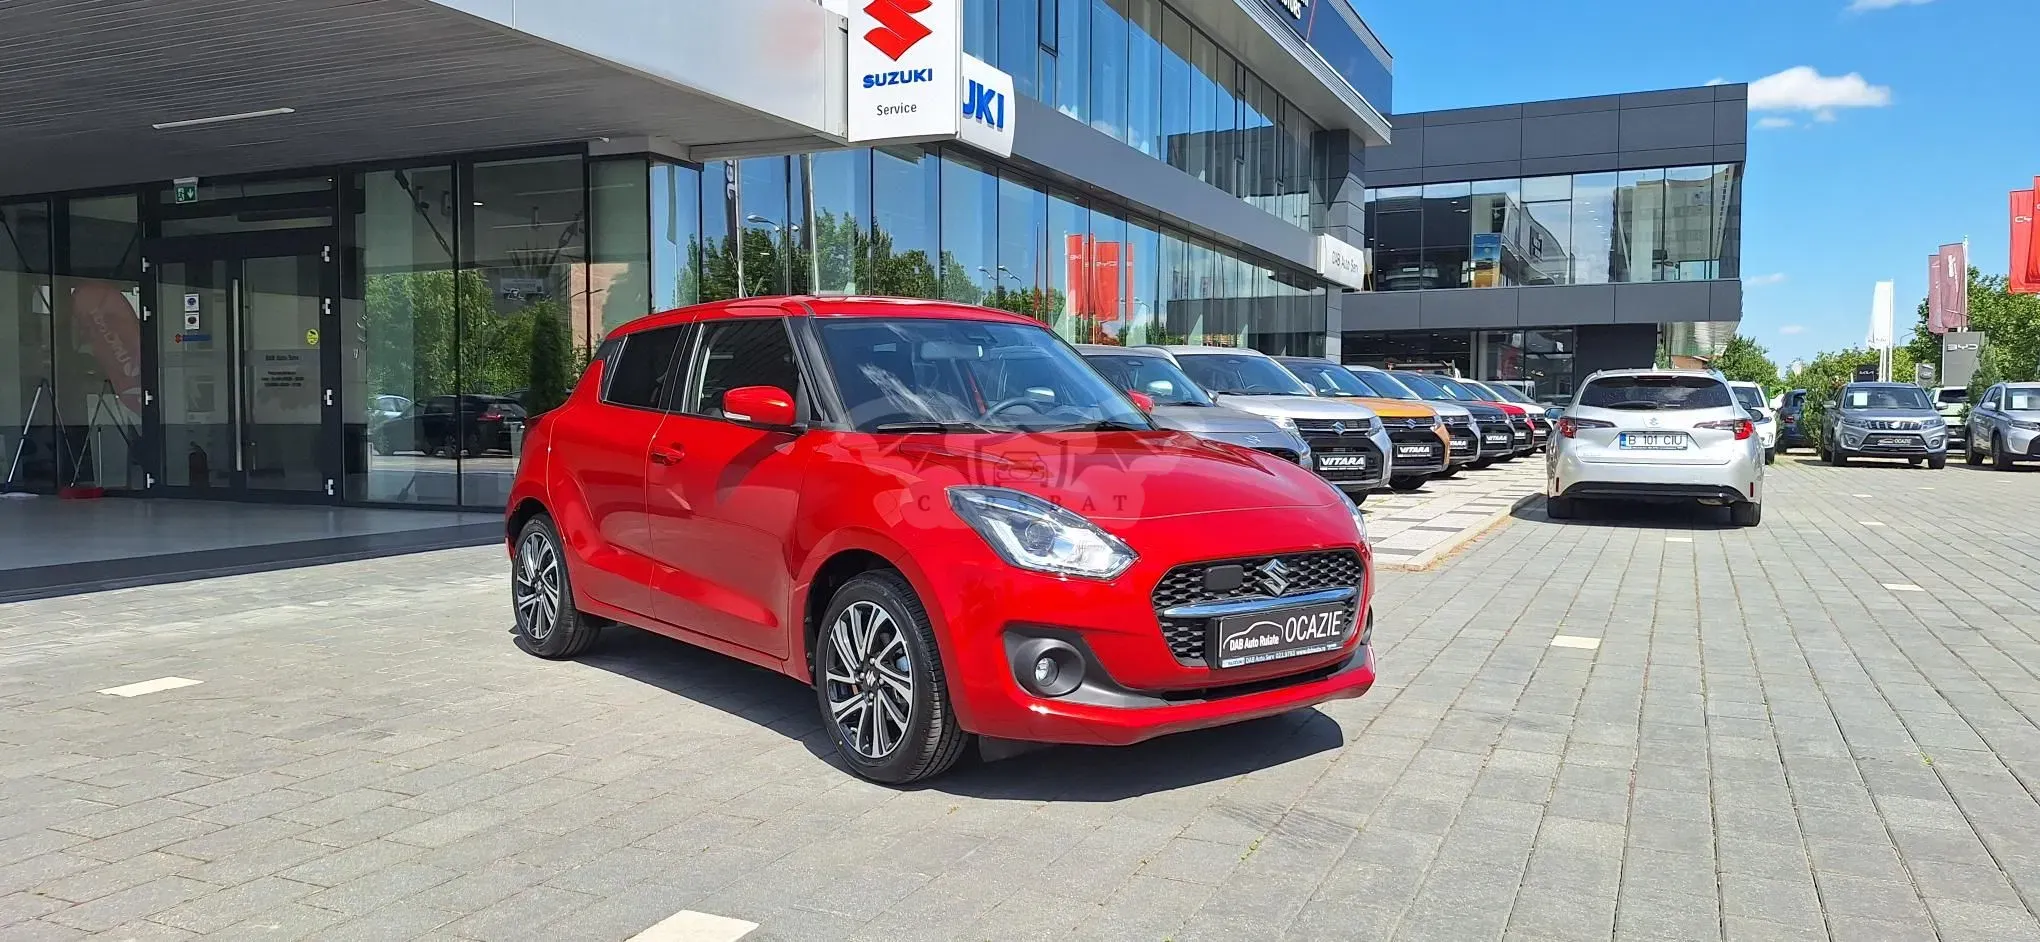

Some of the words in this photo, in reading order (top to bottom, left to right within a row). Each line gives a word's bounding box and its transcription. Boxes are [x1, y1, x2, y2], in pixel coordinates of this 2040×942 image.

[862, 68, 933, 89] SUZUKI
[876, 102, 917, 116] Service
[962, 79, 1005, 130] UKI
[1947, 343, 1978, 351] BYD
[1628, 435, 1636, 445] B
[1644, 435, 1658, 445] 101
[1663, 435, 1683, 445] CIU
[1321, 457, 1364, 466] VITARA
[1285, 611, 1343, 643] OCAZIE
[1229, 638, 1244, 651] DAB
[1244, 637, 1259, 649] Auto
[1259, 634, 1280, 647] Rulate
